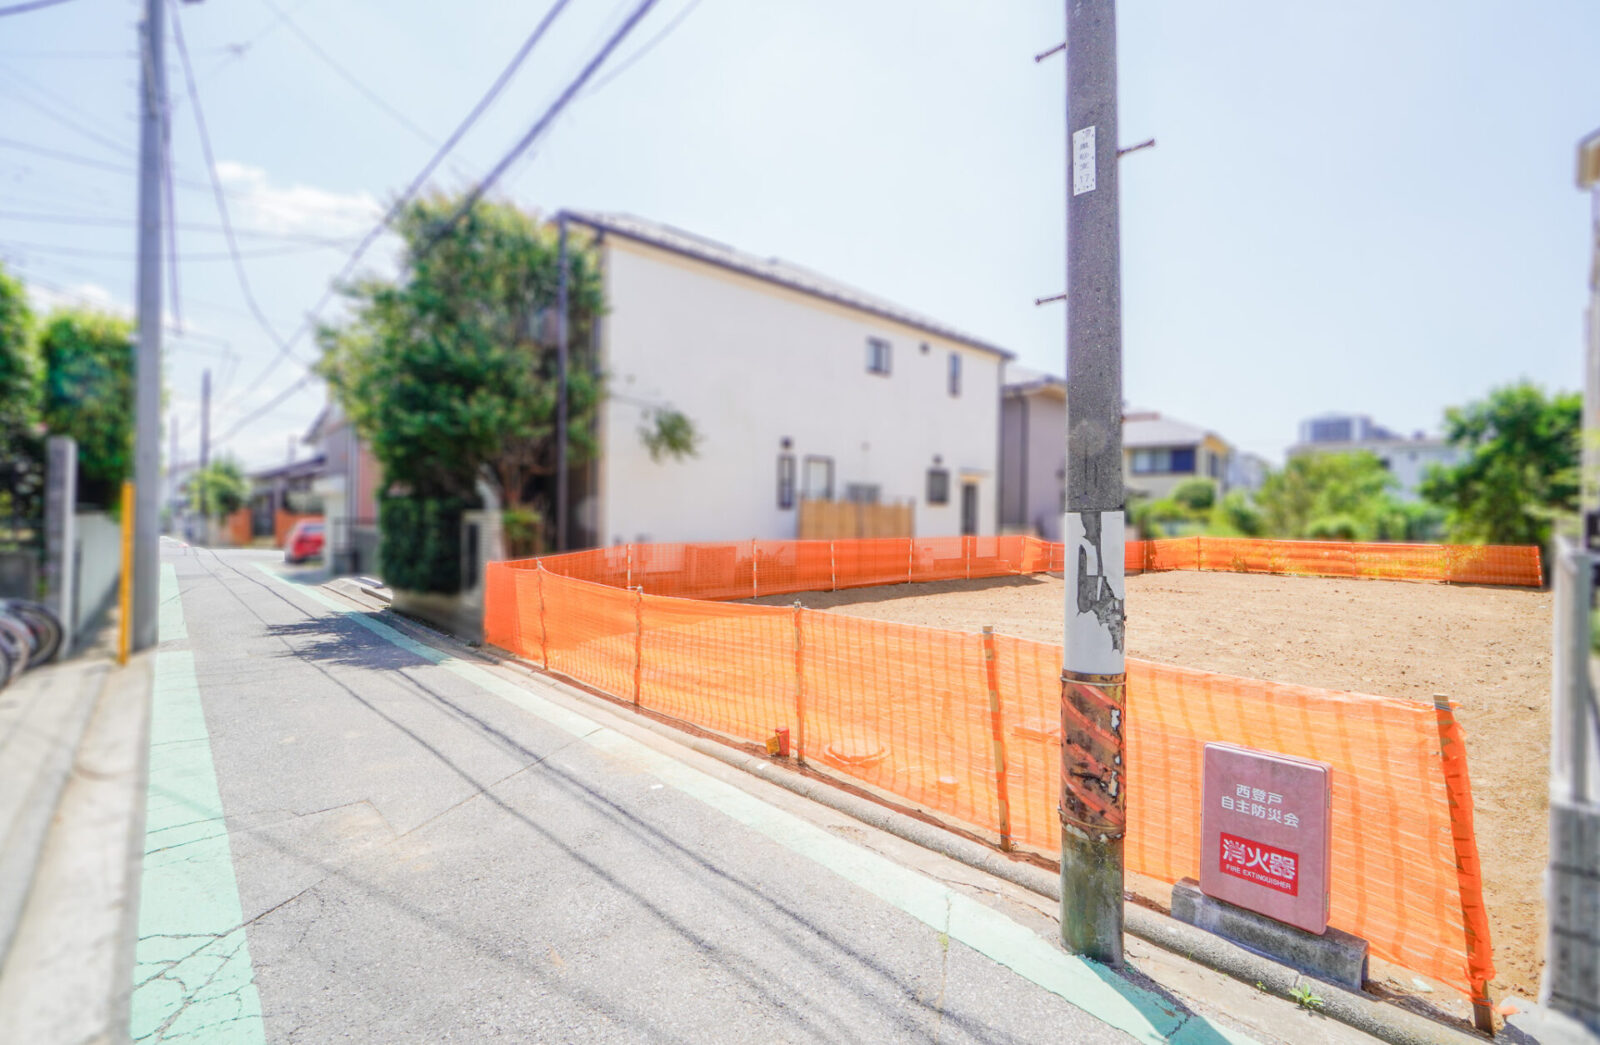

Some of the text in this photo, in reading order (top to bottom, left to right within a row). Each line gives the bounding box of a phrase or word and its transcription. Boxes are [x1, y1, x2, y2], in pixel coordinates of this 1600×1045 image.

[1236, 783, 1283, 805] 西登戸
[1221, 796, 1299, 828] 自主防災会
[1223, 838, 1295, 880] 消火器
[1226, 864, 1291, 889] FIRE EXTINGUISHER
